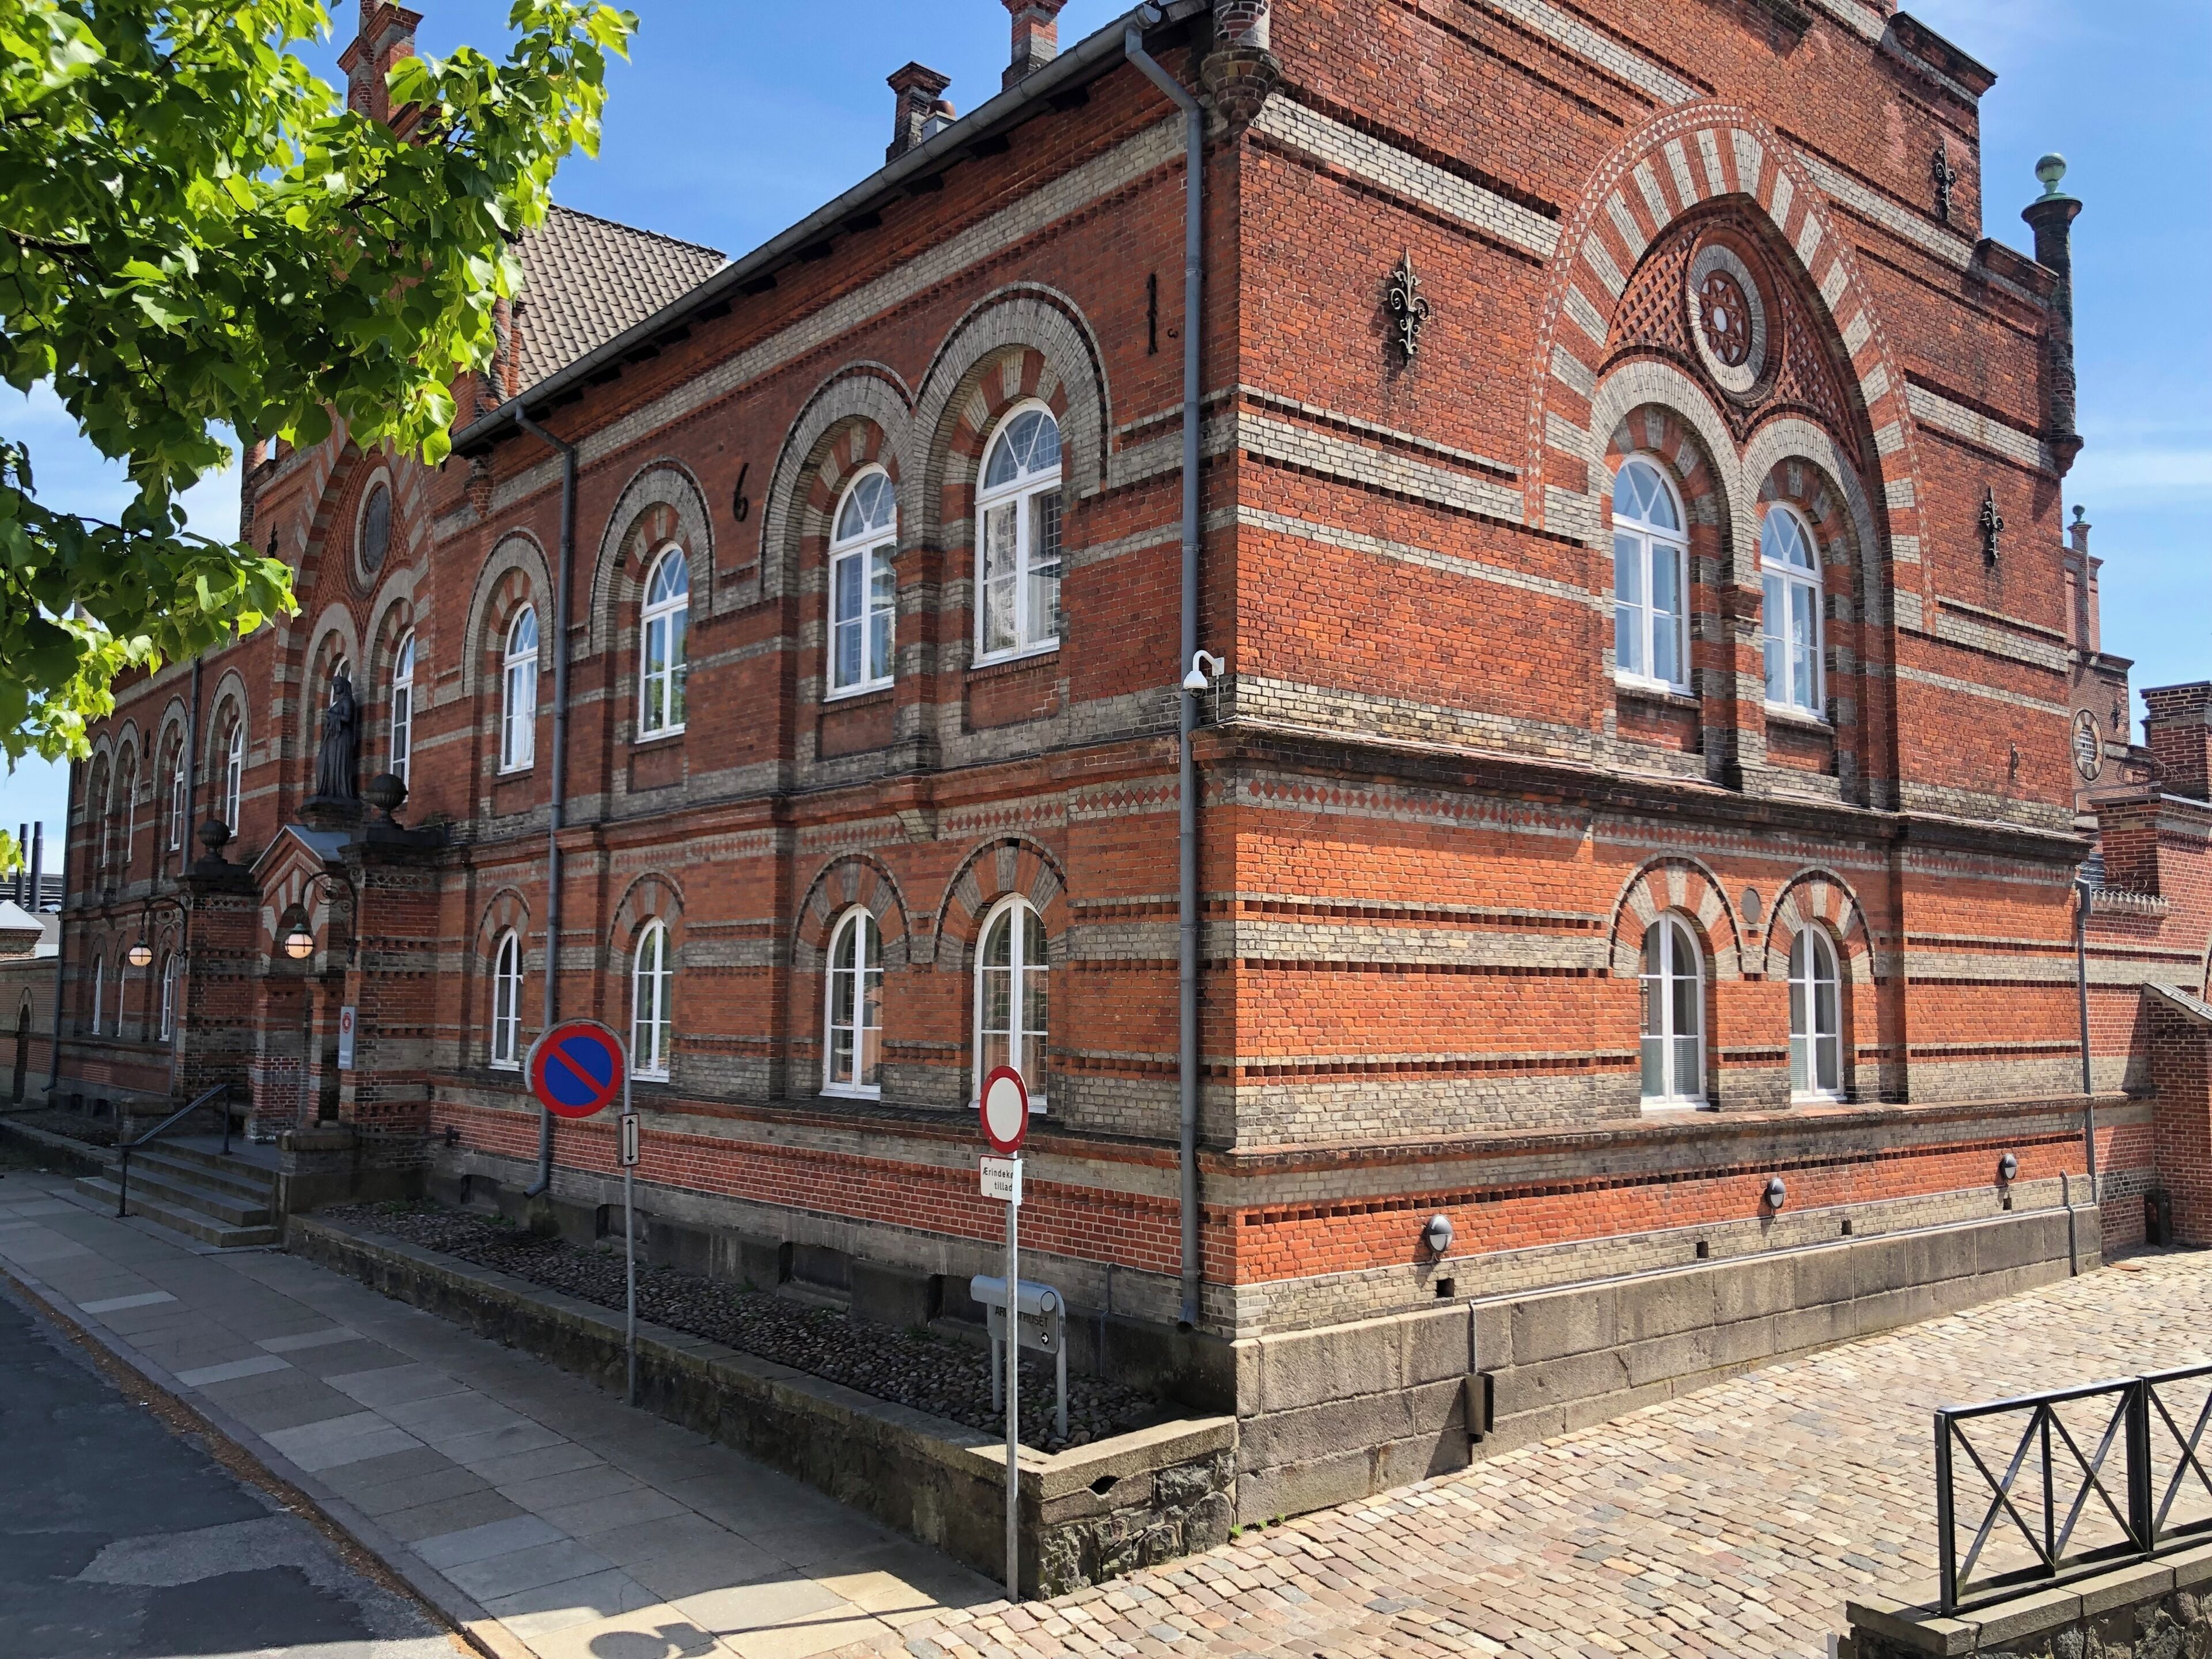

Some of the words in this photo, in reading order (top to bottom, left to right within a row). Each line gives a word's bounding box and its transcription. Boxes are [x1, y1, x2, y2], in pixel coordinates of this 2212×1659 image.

[983, 1166, 1013, 1179] Ærindekø
[994, 1181, 1012, 1191] tillad
[995, 1305, 1048, 1327] ARTHUSET
